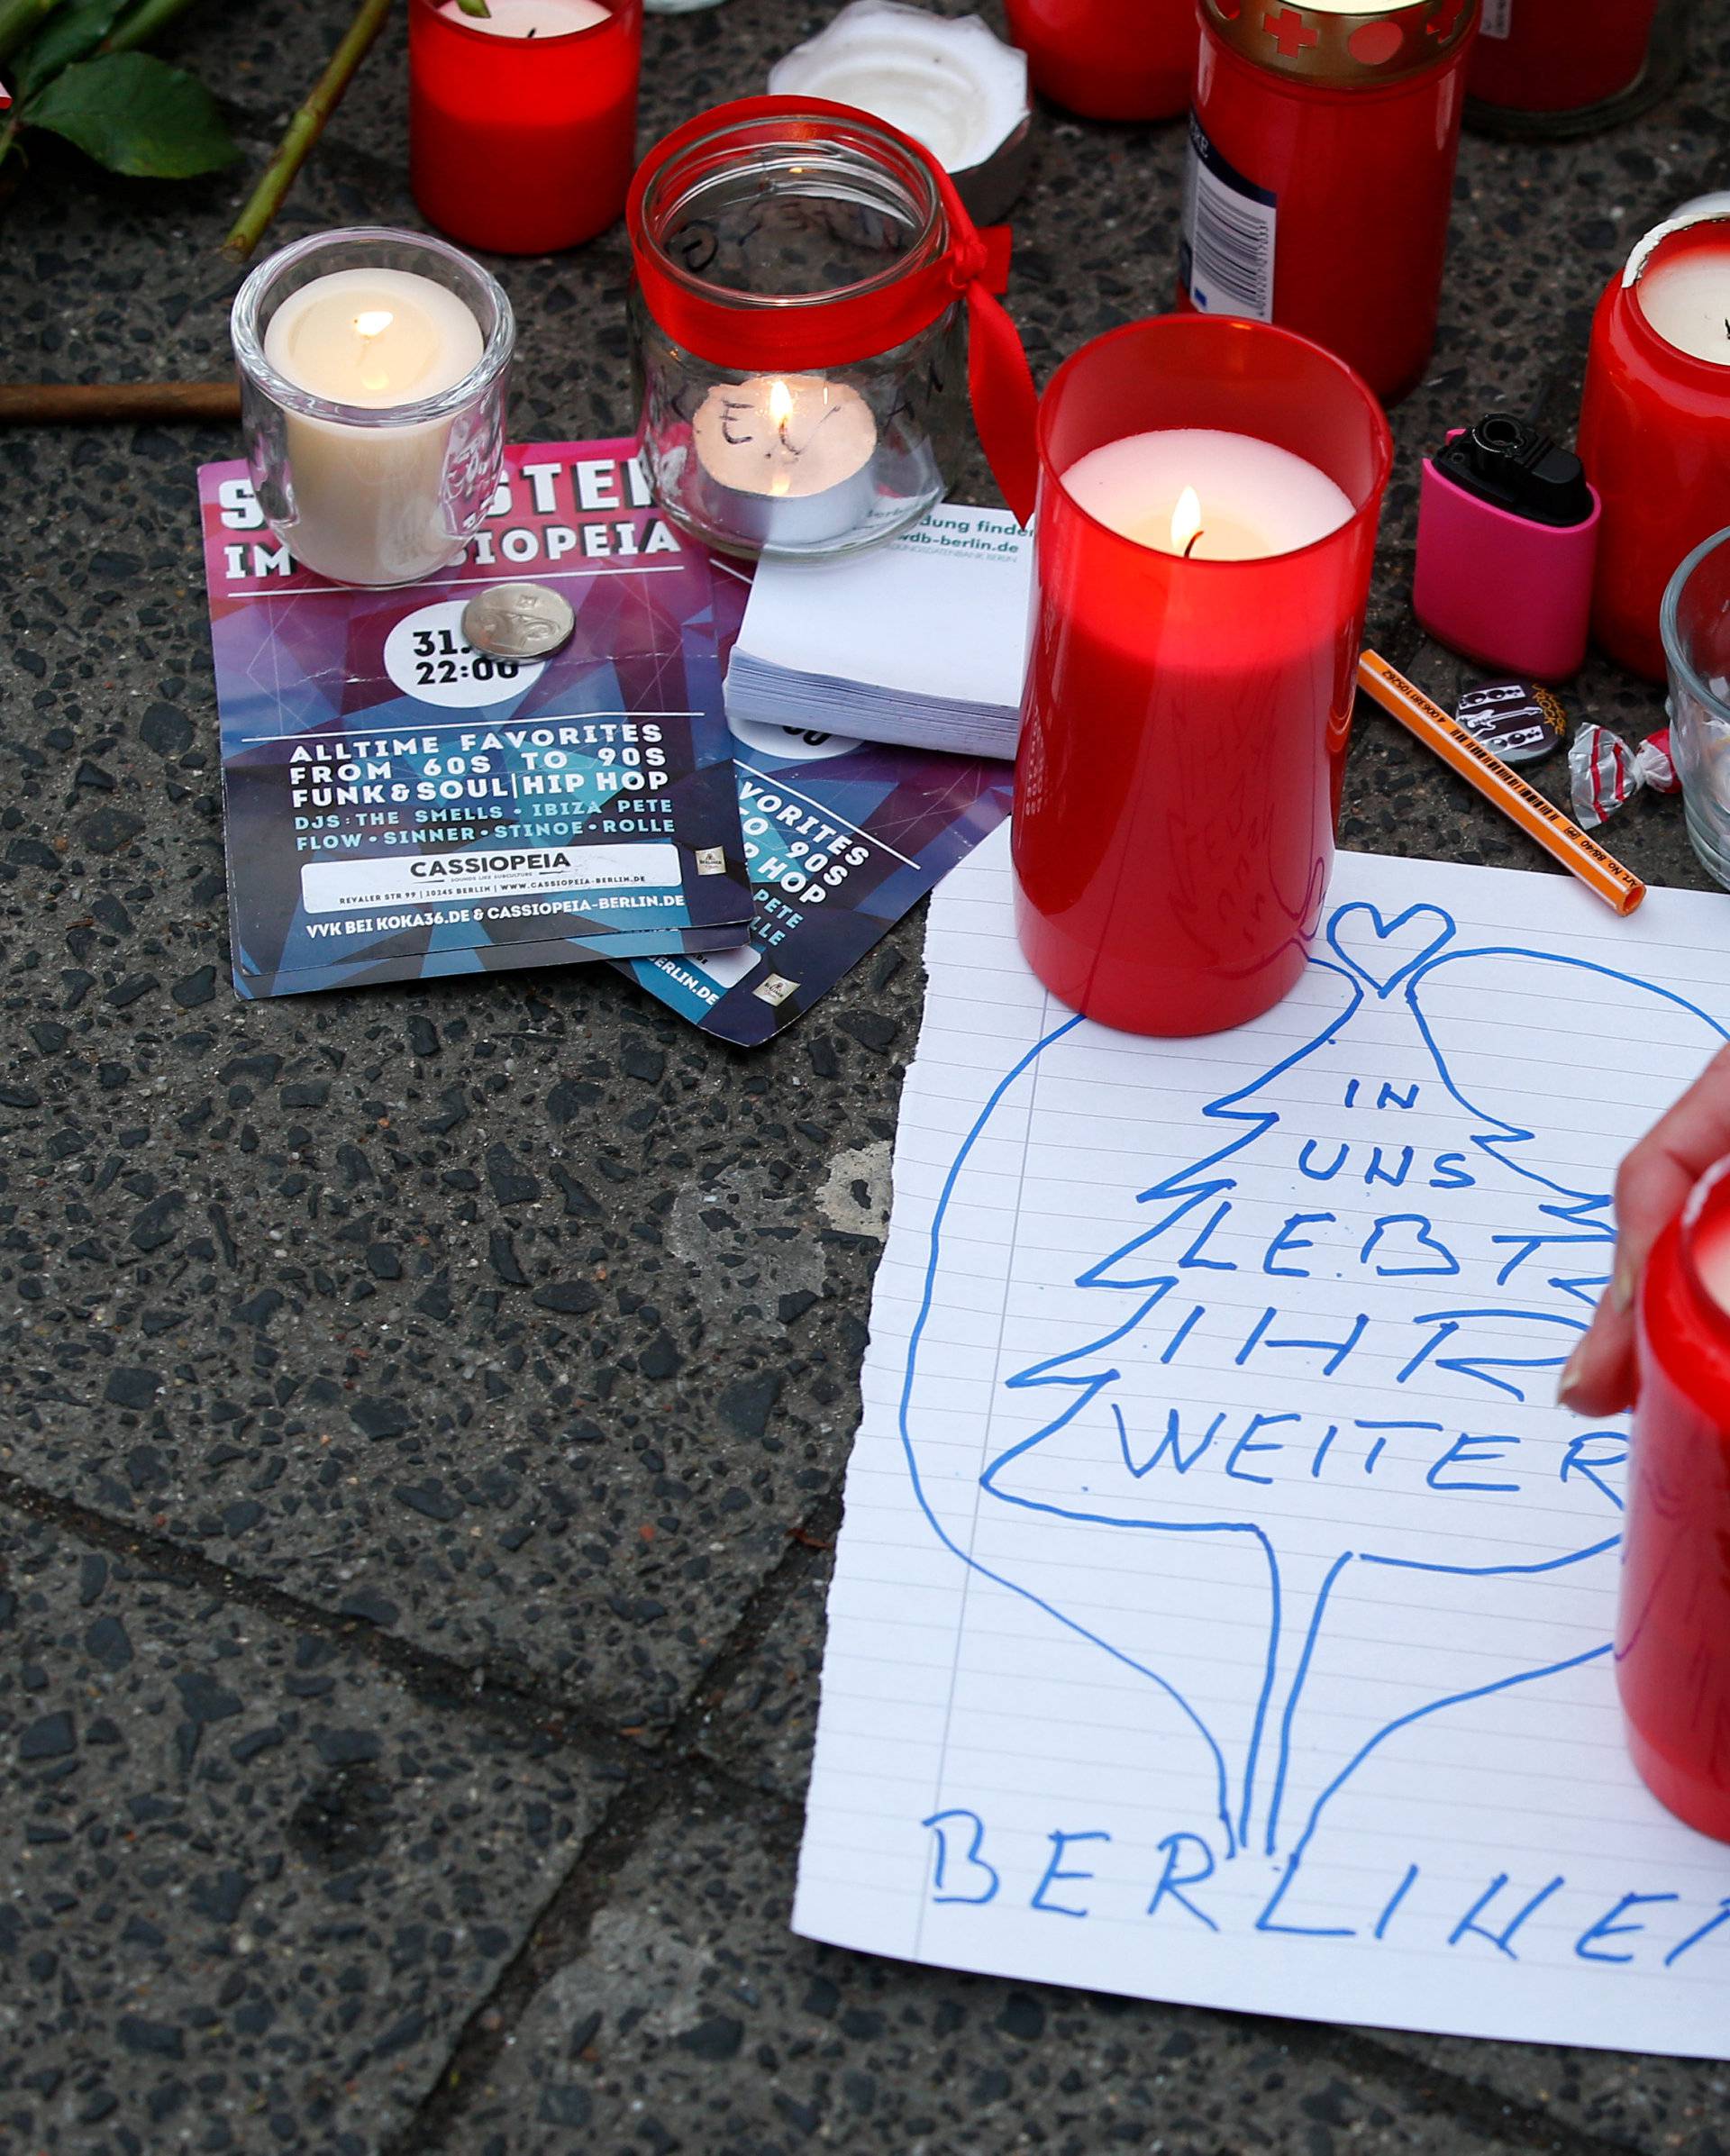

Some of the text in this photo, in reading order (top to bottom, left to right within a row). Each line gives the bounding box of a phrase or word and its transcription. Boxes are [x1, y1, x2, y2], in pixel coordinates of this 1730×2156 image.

[223, 520, 682, 580] IM IOPEIA
[414, 656, 520, 686] 22:00
[288, 723, 663, 764] ALLTIME FAVORITES
[289, 746, 667, 786] FROM 60S TO 90S
[596, 770, 669, 792] HOP
[414, 805, 504, 824] SMELLS
[532, 800, 603, 817] IBIZA
[617, 798, 673, 814] PETE
[737, 780, 870, 867] VORITES
[296, 818, 676, 851] FLOW SINNER STINOE ROLLE
[410, 851, 572, 878] CASSIOPEIA
[757, 857, 827, 905] HOP
[785, 841, 849, 887] 90S
[339, 893, 382, 905] REVALER
[384, 890, 403, 901] STR
[405, 890, 417, 899] 99
[500, 875, 646, 891] WWW.CASSIOPEIA-BERLIN.DE
[751, 887, 805, 930] PETE
[305, 895, 686, 939] VVK BEI KOKA36.DE & CASSIOPEIA-BERLIN.DE
[750, 914, 786, 947] LLE
[1343, 1078, 1420, 1109] IN
[1298, 1139, 1477, 1188] UNS
[1177, 1201, 1618, 1287] LEBT
[1159, 1305, 1591, 1403] IHR
[1110, 1402, 1628, 1512] WEITER
[921, 1808, 1730, 1969] BERLINE
